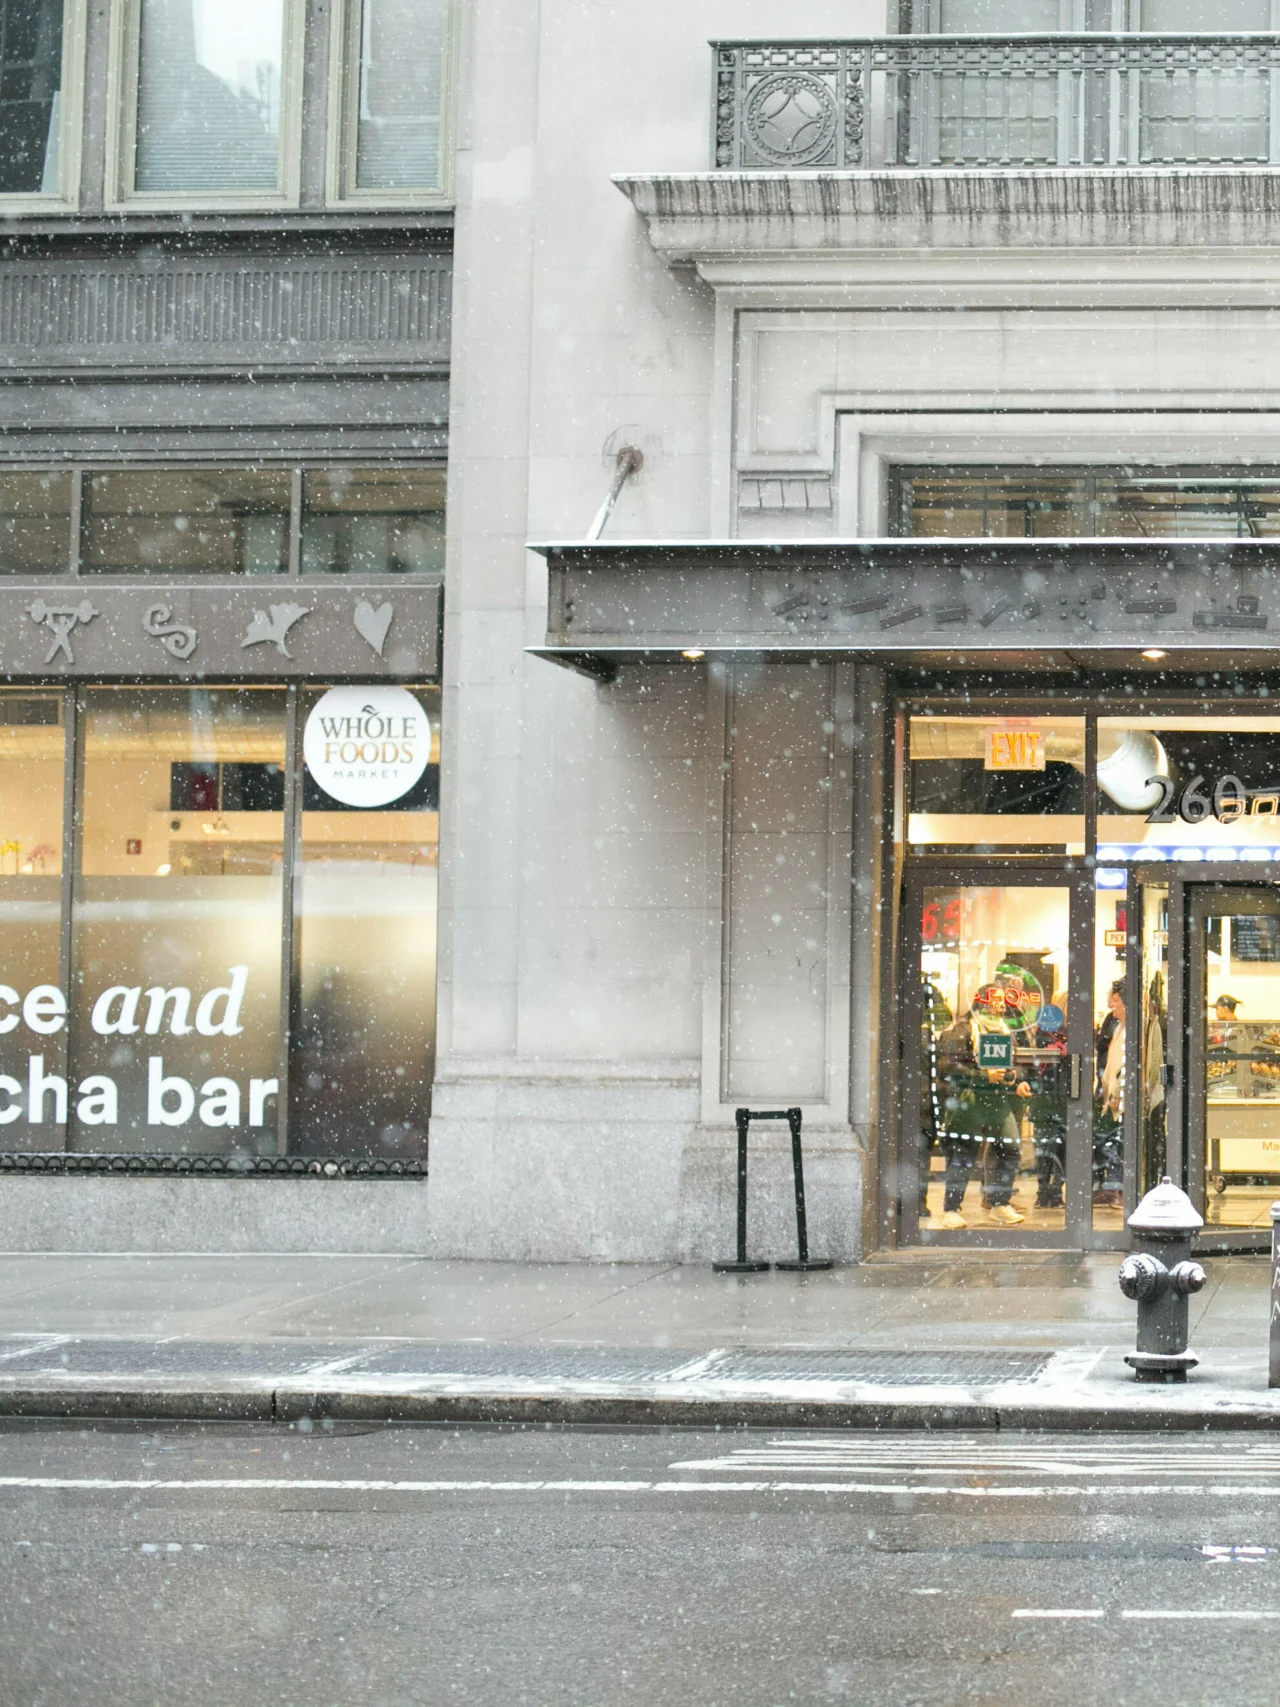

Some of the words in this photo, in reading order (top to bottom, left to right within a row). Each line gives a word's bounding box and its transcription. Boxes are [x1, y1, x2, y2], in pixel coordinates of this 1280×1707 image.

[318, 705, 417, 739] WHOLE
[323, 742, 414, 764] FOODS
[991, 732, 1040, 767] EXIT
[333, 769, 399, 779] MARKET
[1144, 774, 1246, 825] 260
[91, 965, 249, 1037] and
[983, 1044, 1007, 1058] IN
[147, 1056, 279, 1127] bar
